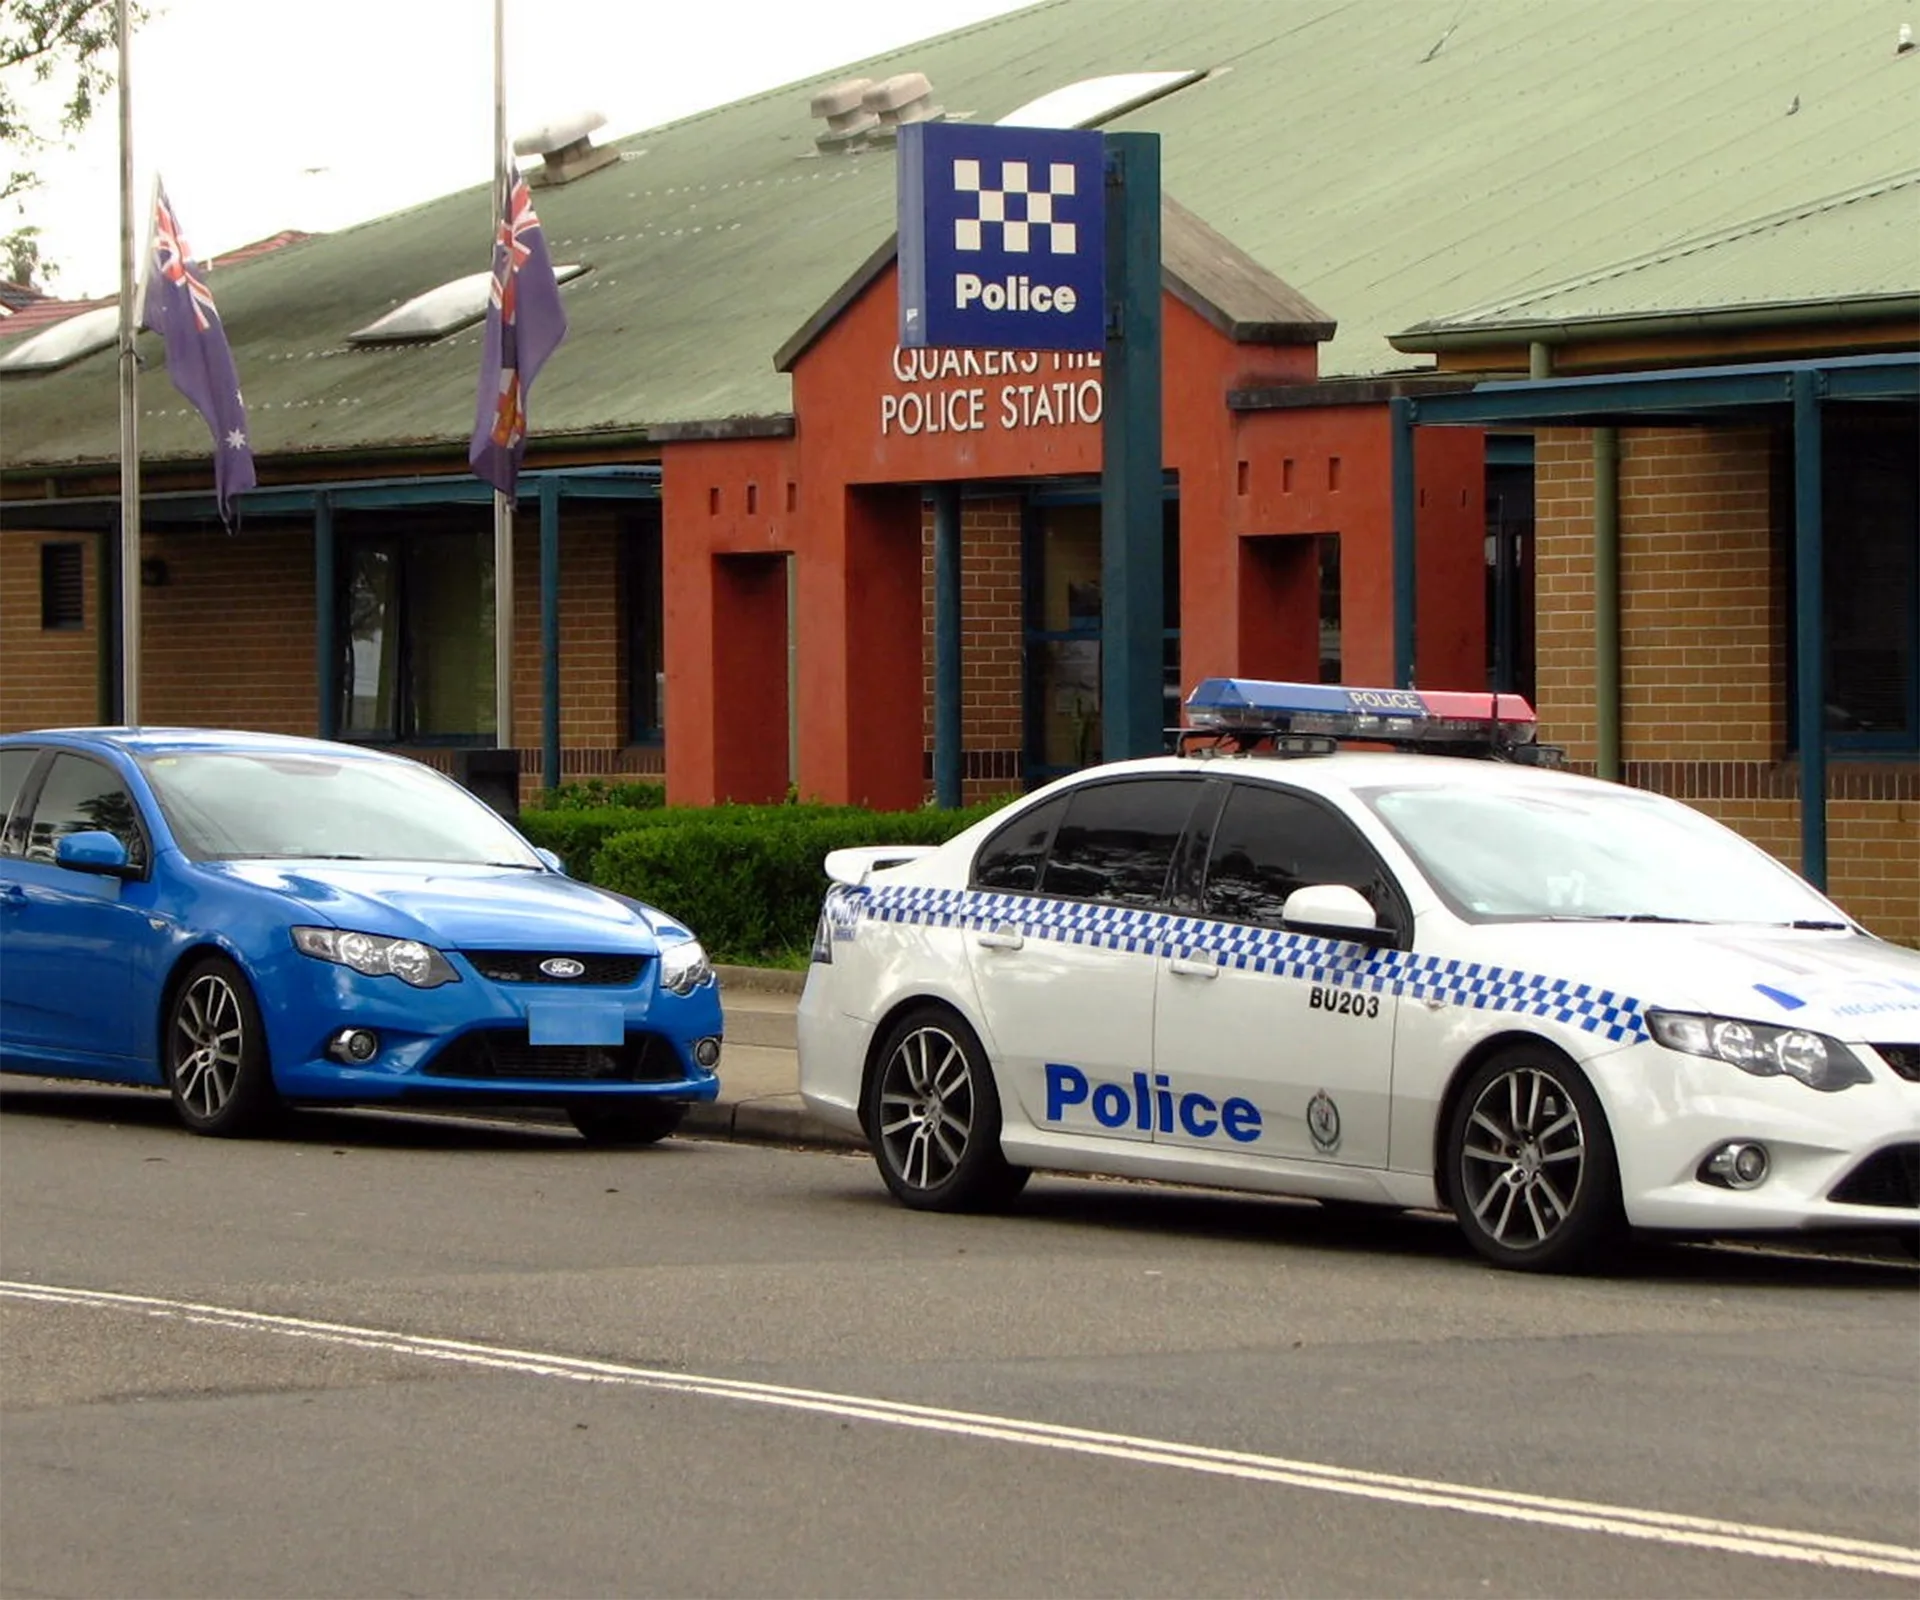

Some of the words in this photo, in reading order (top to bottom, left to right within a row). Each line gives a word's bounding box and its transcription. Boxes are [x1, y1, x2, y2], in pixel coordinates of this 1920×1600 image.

[956, 273, 1077, 313] Police
[881, 388, 985, 435] POLICE
[1001, 379, 1103, 429] STATIO
[1349, 692, 1421, 709] POLICE
[1309, 986, 1380, 1018] BU203
[1045, 1063, 1262, 1142] Police
